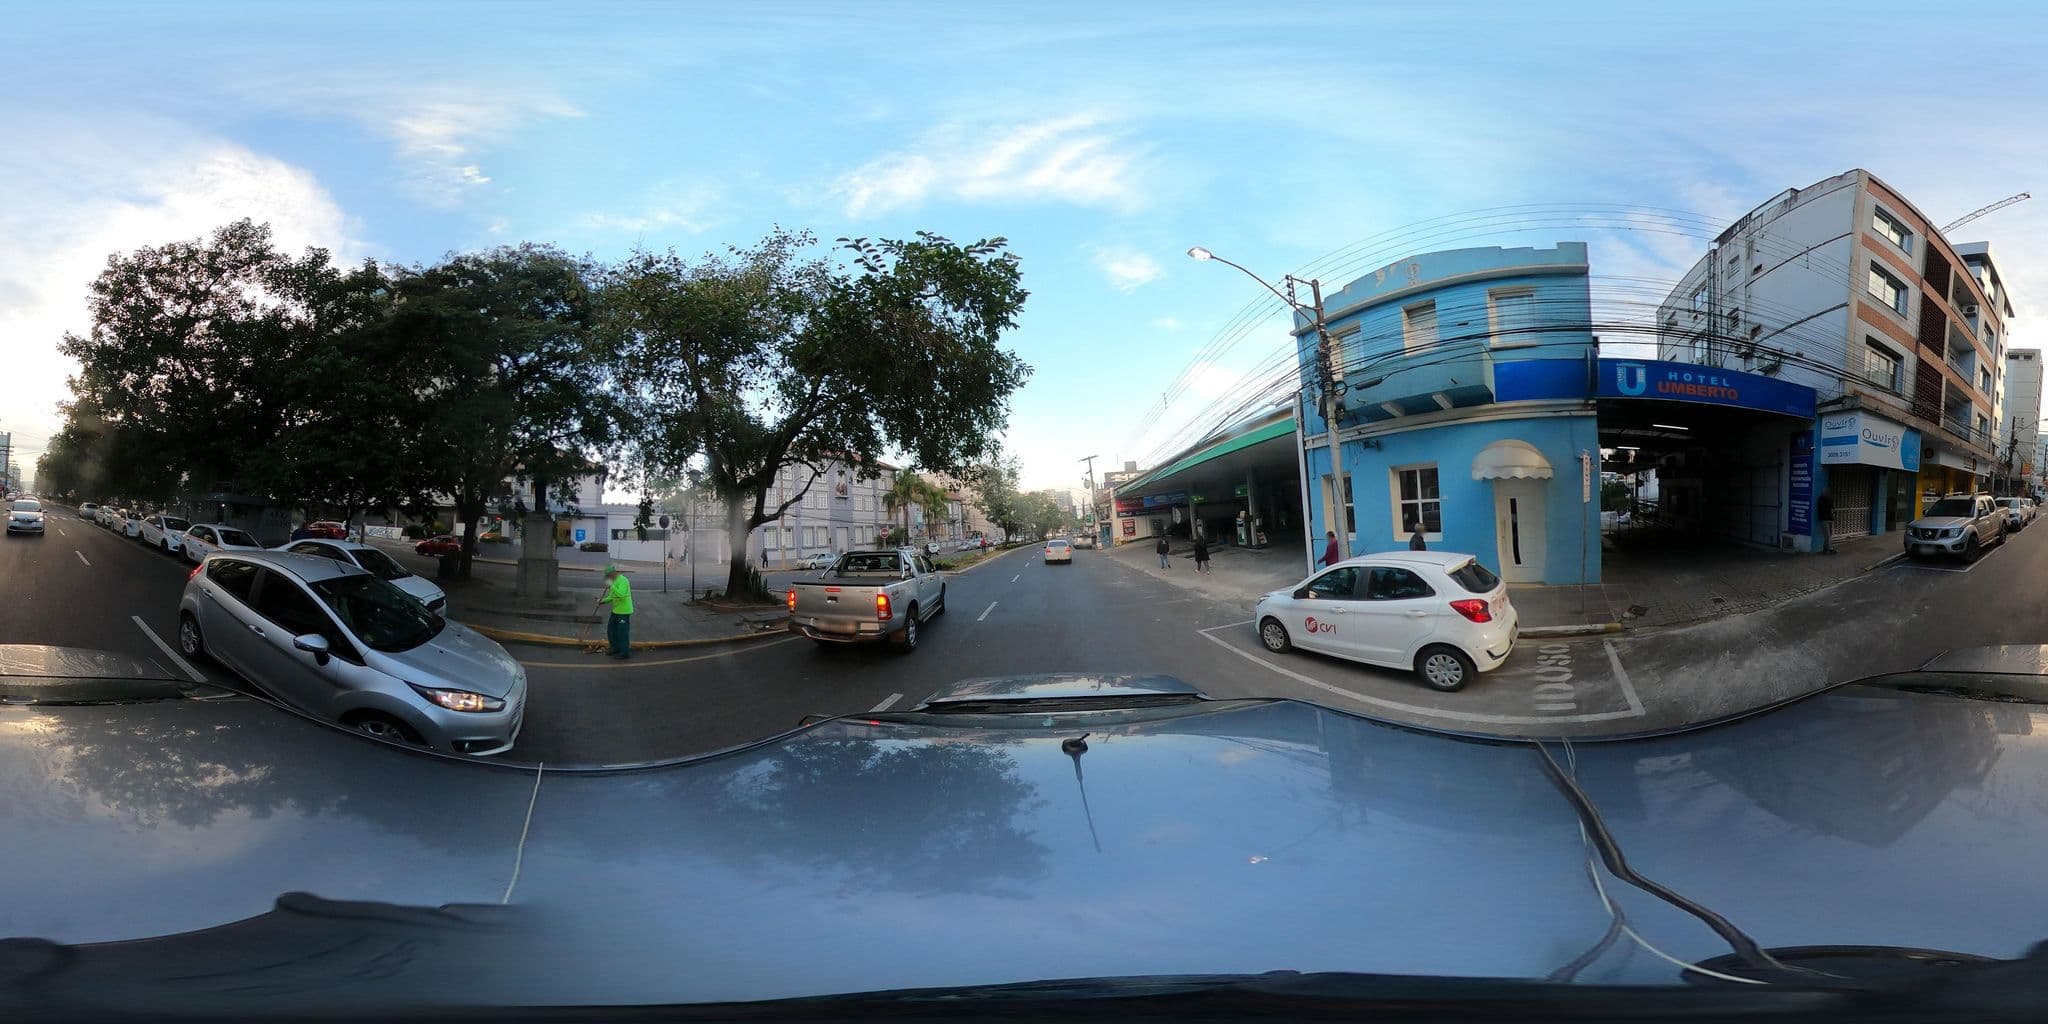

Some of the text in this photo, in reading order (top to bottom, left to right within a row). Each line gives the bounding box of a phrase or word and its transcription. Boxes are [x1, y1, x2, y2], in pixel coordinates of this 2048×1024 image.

[1668, 371, 1729, 387] HOTEL
[1657, 381, 1739, 400] UMBERTO
[1535, 644, 1576, 711] IDOSO
